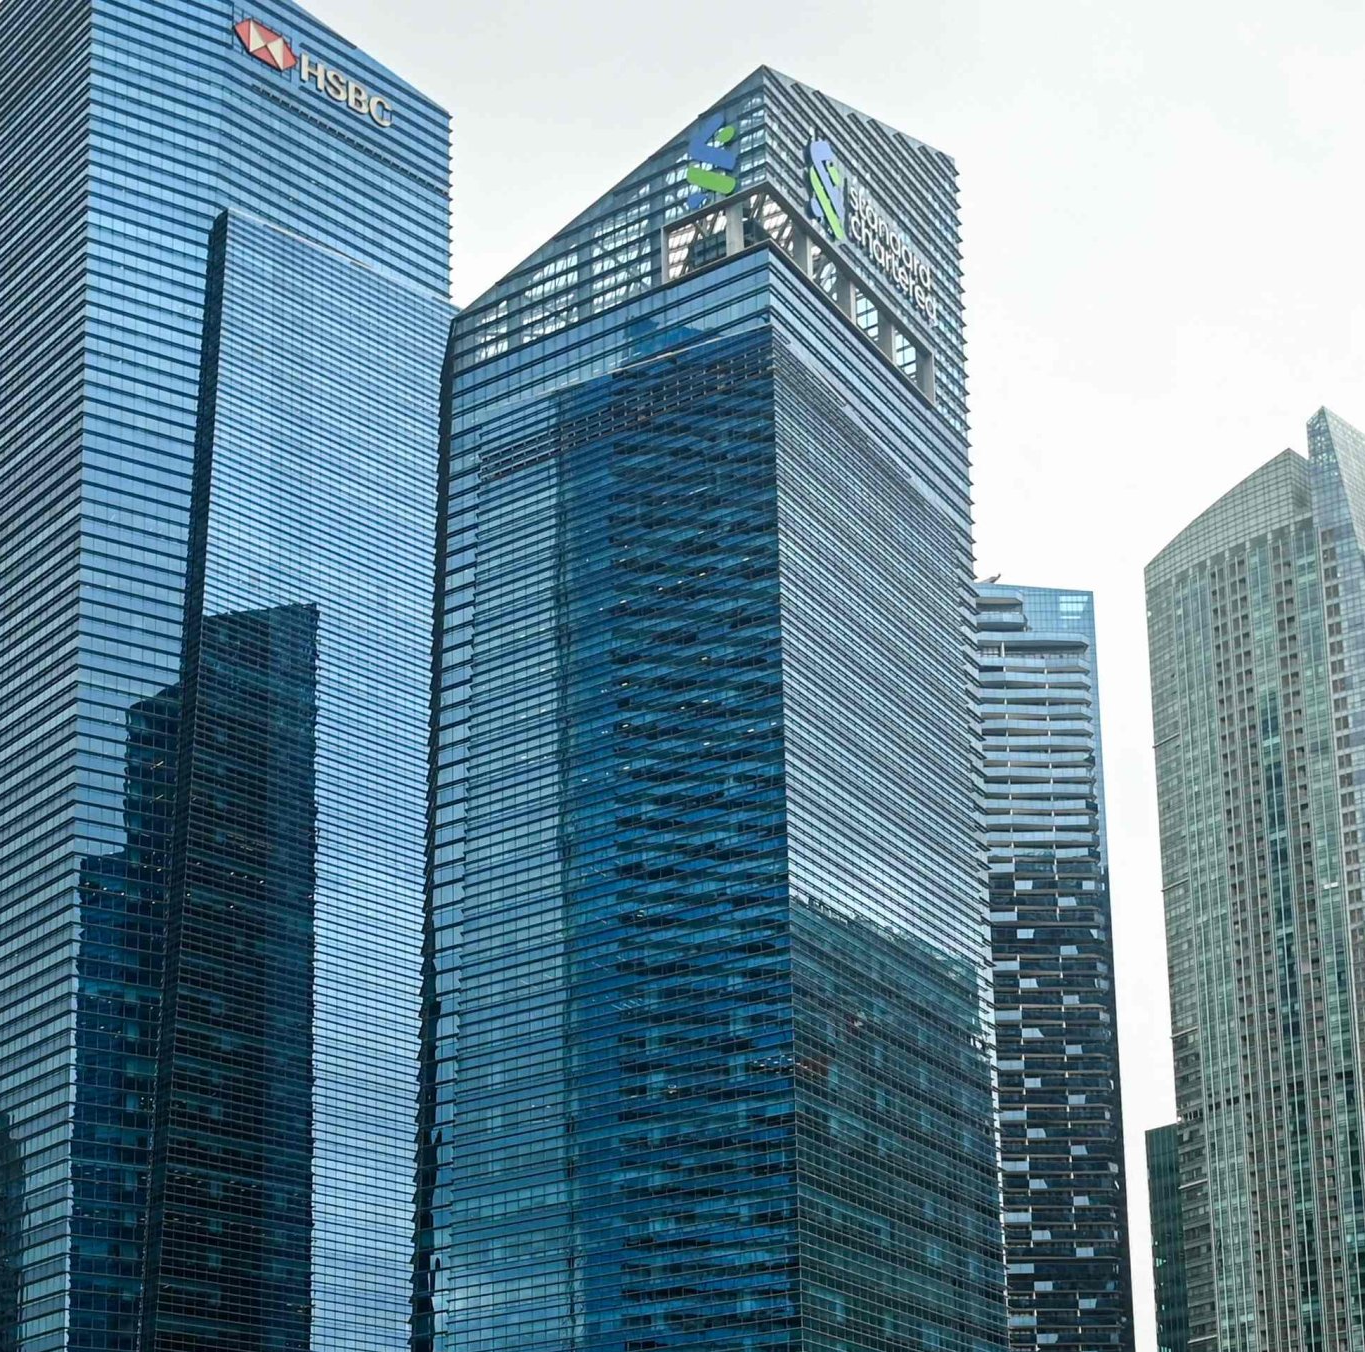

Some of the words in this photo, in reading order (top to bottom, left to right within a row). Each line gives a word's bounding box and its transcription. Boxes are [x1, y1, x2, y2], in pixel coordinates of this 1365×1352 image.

[299, 52, 393, 127] HSBC
[849, 186, 931, 290] standard
[850, 215, 936, 321] chartered
